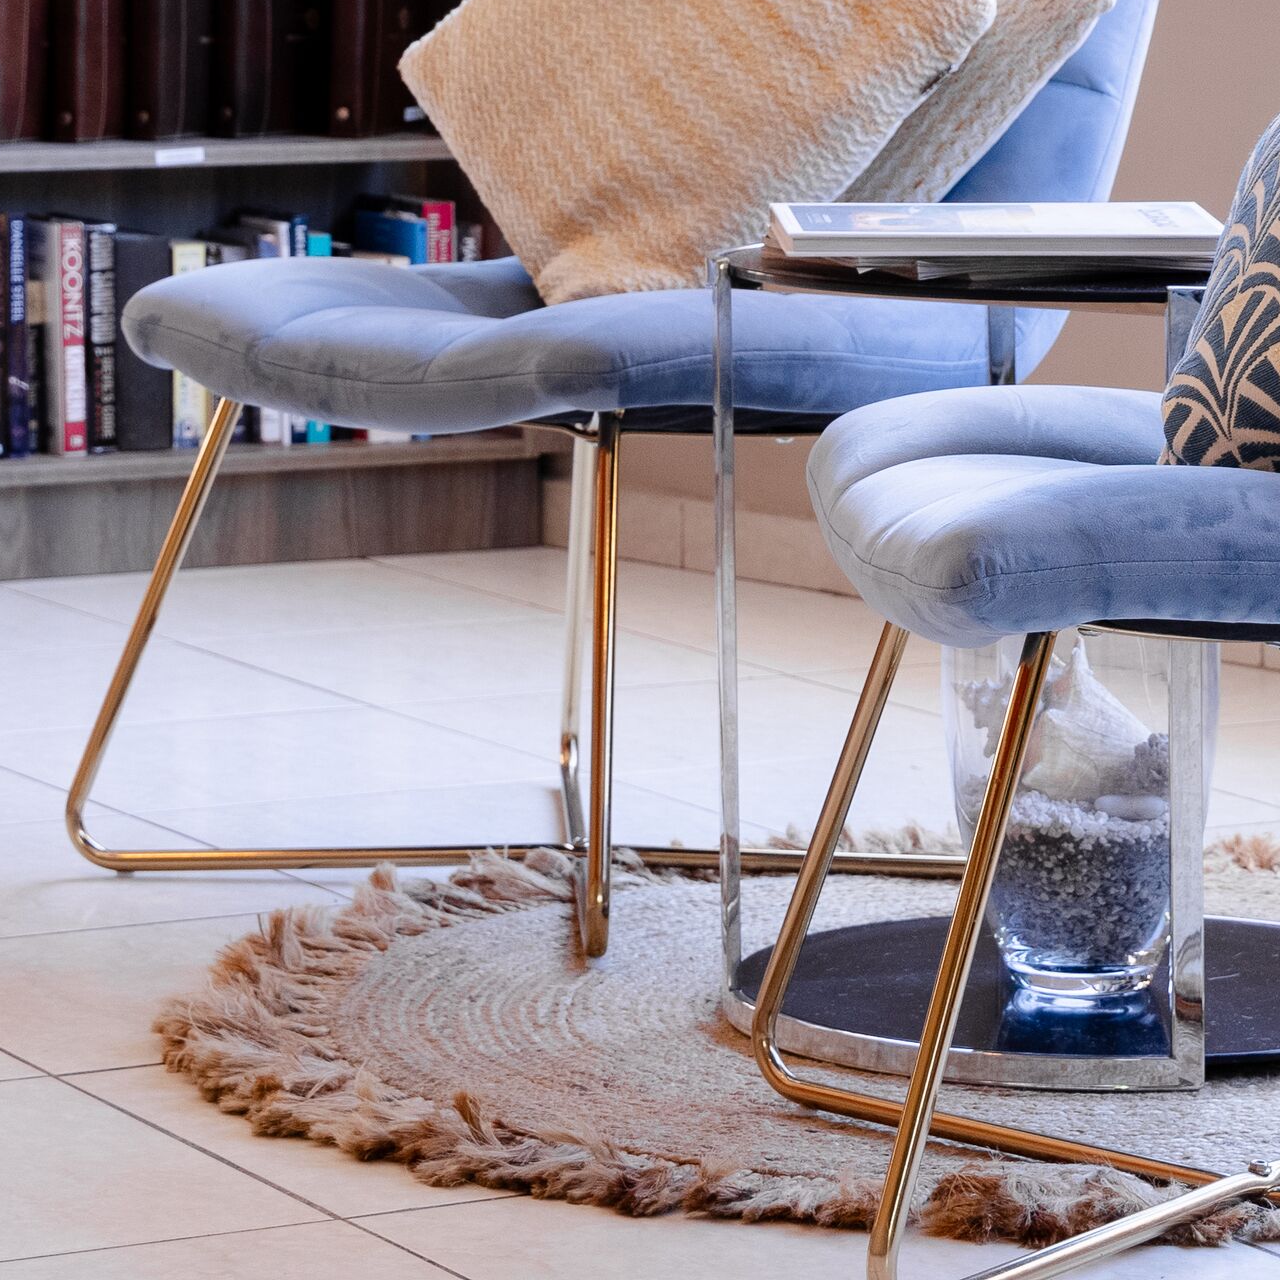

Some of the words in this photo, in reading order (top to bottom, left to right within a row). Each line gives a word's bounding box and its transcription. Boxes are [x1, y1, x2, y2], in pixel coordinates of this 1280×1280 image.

[10, 220, 24, 283] DANIELLE
[10, 285, 24, 322] STEEL
[62, 238, 83, 339] KOONTZ
